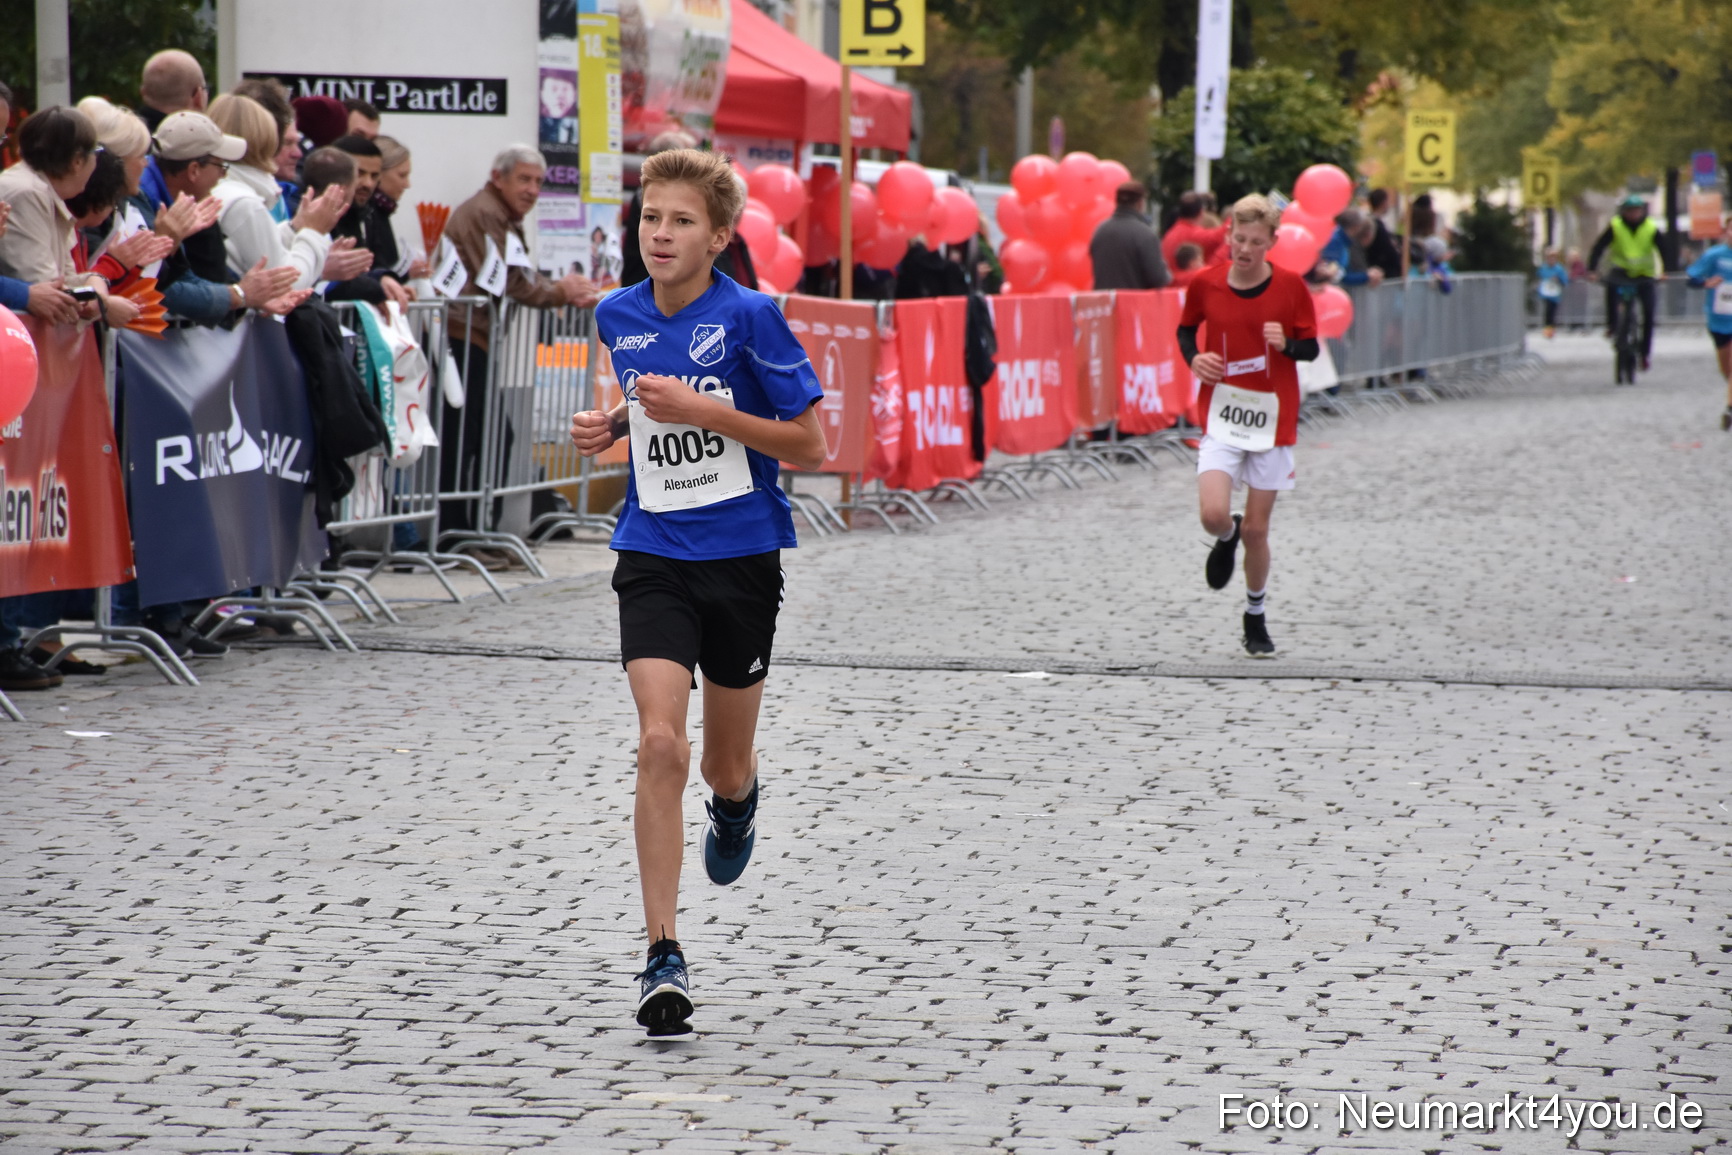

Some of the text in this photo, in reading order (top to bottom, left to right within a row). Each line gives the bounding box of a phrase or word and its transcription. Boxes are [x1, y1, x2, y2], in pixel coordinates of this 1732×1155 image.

[864, 0, 903, 36] B
[1418, 132, 1441, 166] C
[1532, 171, 1549, 196] D
[613, 335, 644, 353] JURA
[692, 329, 724, 360] BERNGAU
[696, 328, 711, 343] FSV
[710, 344, 722, 356] 1949
[1220, 404, 1267, 429] 4000
[648, 428, 725, 468] 4005
[664, 472, 719, 491] Alexander
